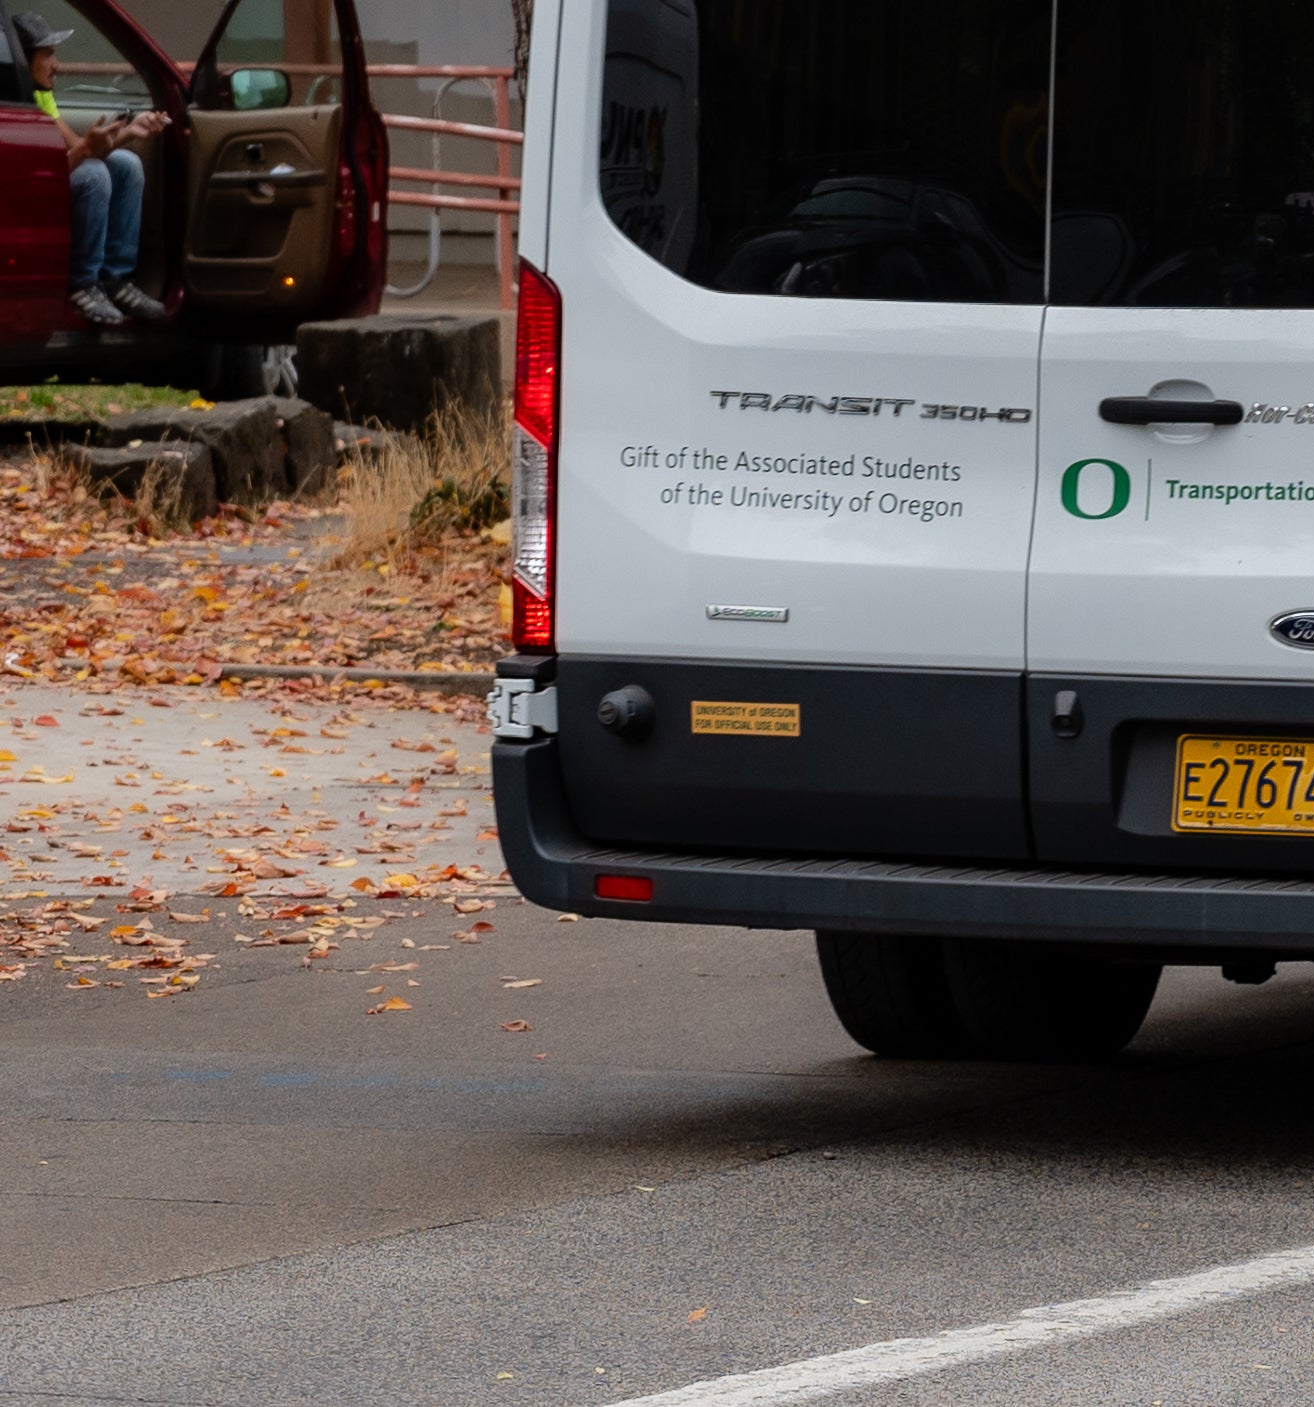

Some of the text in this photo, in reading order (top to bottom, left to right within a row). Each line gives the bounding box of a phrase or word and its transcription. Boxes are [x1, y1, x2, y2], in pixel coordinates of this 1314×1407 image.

[710, 390, 1033, 424] TRANSIT 350HD
[620, 445, 962, 482] Gift of the Associated Students
[1060, 458, 1131, 520] O
[660, 482, 965, 523] of the University of Oregon
[695, 705, 747, 716] UNIVERSITY
[759, 707, 796, 718] OREGON
[695, 718, 711, 729] FOR
[714, 719, 752, 730] OFFICIAL
[1235, 743, 1306, 758] OREGON
[1183, 808, 1265, 820] PUBLICLY
